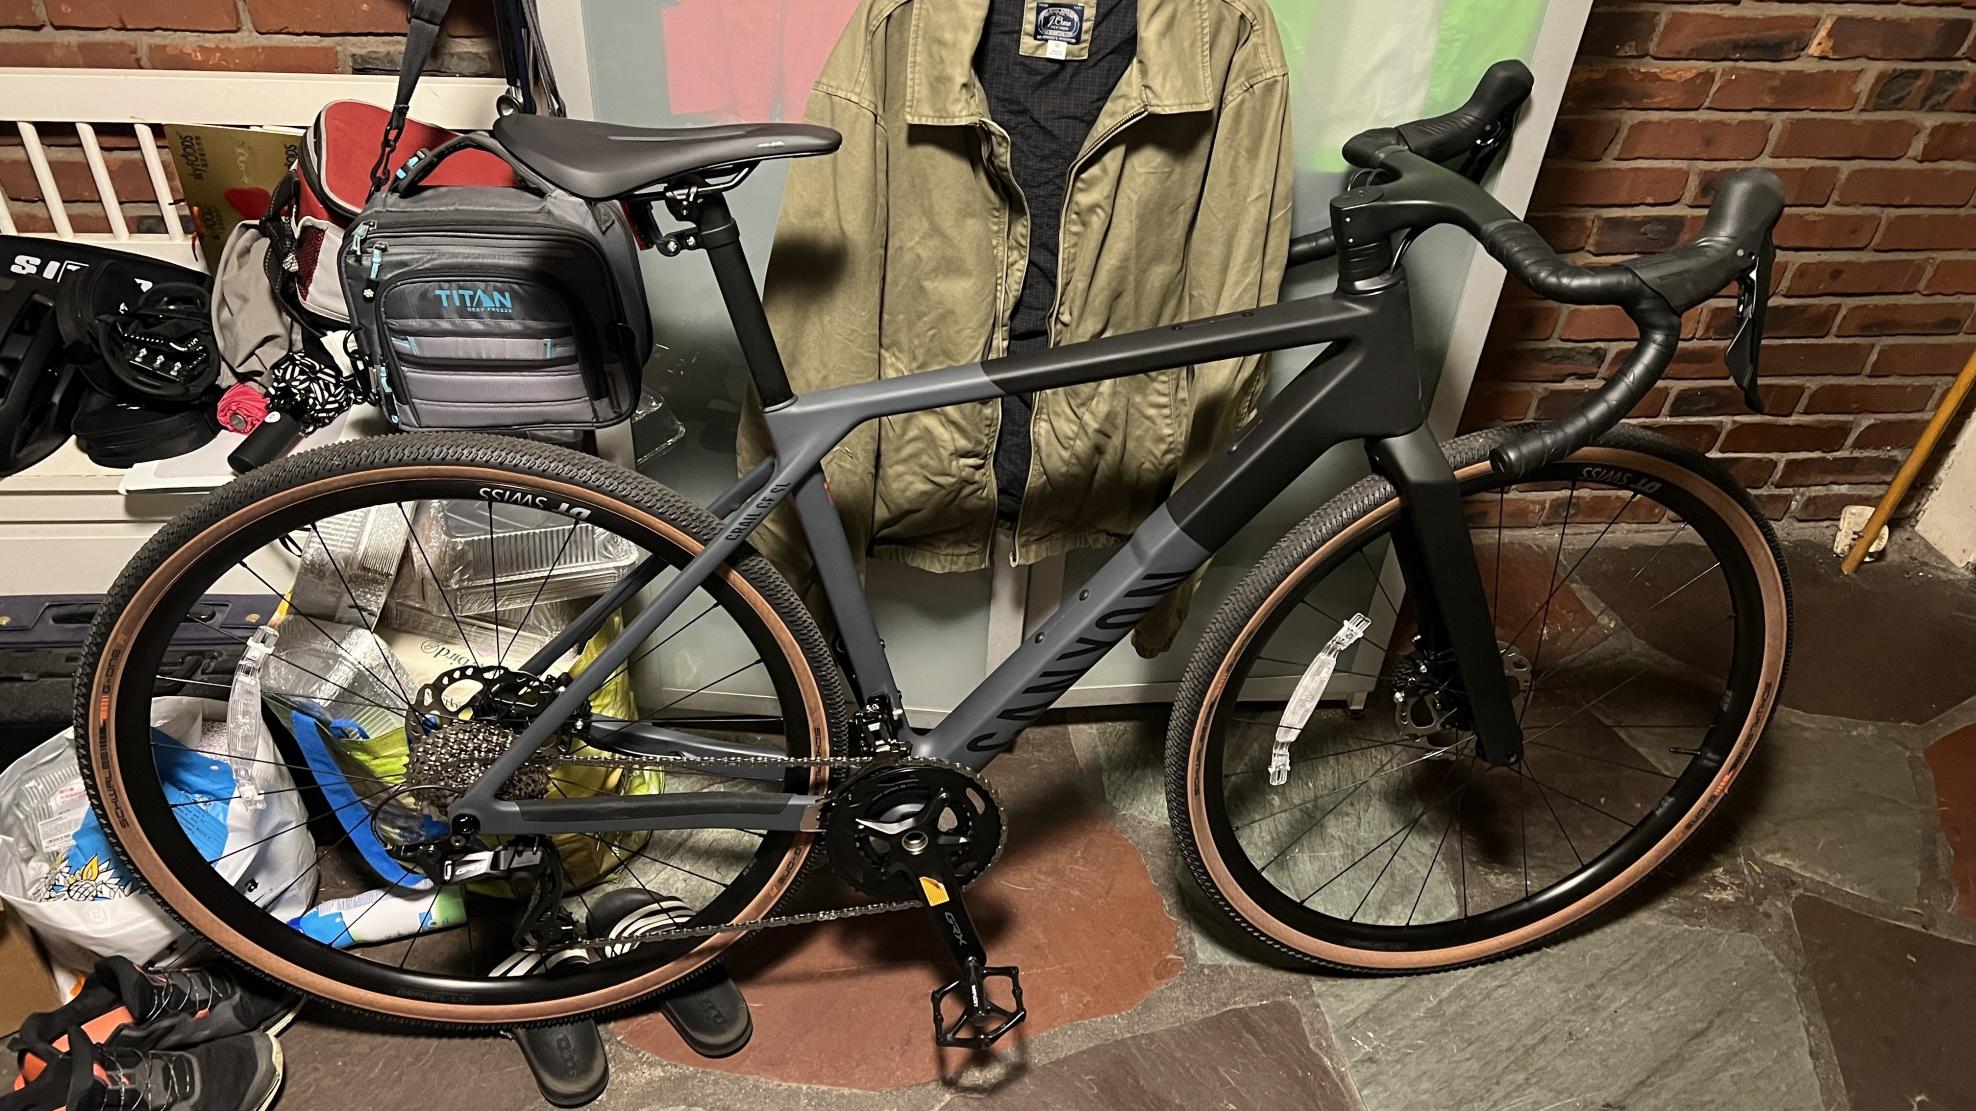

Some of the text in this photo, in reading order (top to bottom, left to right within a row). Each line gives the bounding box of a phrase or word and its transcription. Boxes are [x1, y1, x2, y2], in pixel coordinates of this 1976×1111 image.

[434, 288, 513, 308] TITAN
[770, 482, 792, 494] SL
[1579, 467, 1633, 486] SWISS
[479, 487, 592, 520] DT SWISS
[966, 569, 1193, 752] CANYON
[945, 911, 967, 946] GRX
